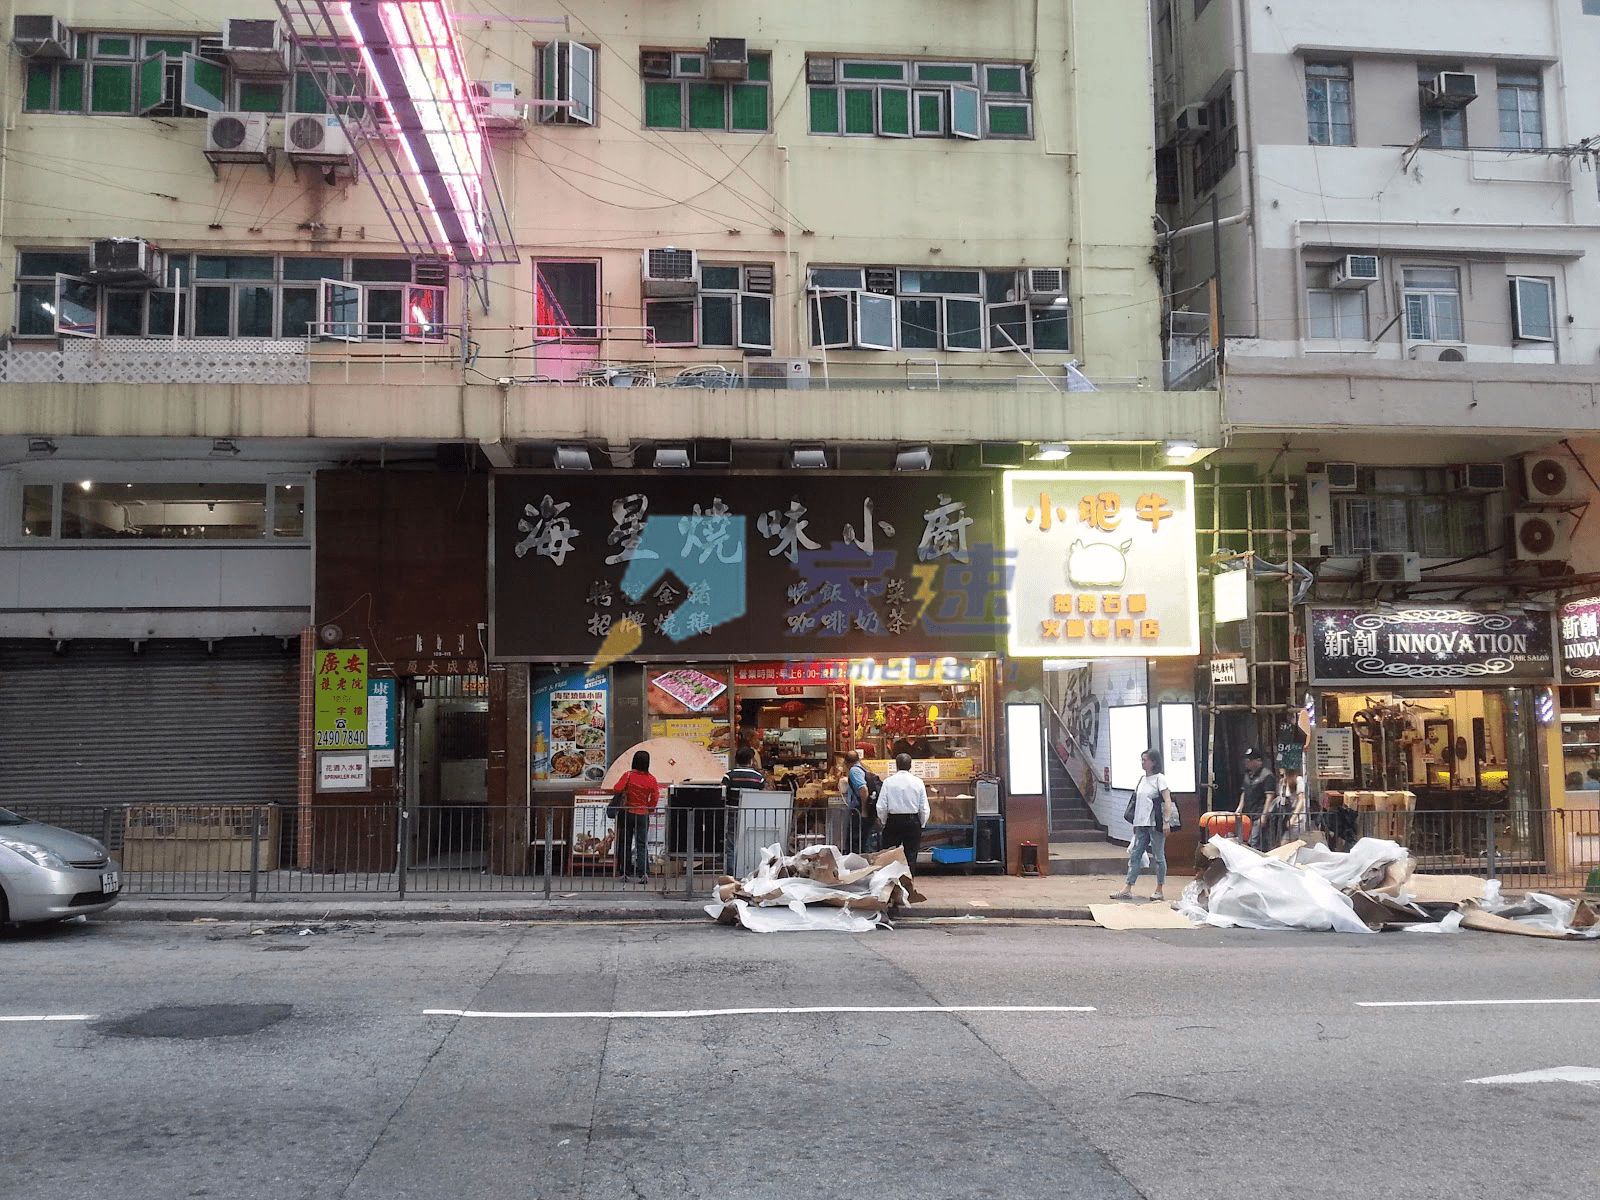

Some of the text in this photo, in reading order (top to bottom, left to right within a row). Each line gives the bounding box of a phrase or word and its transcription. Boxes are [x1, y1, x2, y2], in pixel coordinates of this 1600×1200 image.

[1026, 491, 1174, 534] 小肥牛
[514, 493, 975, 566] 海星燒味小廚
[787, 578, 911, 605] 晚飯小菜
[587, 609, 714, 637] 招牌燒鵝
[787, 608, 912, 636] 咖啡奶茶
[1041, 618, 1160, 639] 火門店
[1562, 611, 1598, 640] 新創
[1324, 629, 1377, 657] 新創
[1388, 630, 1527, 654] INNOVATION
[319, 652, 365, 676] 廣安
[1509, 654, 1549, 662] HAIR SALON
[317, 729, 365, 746] 2490 7840
